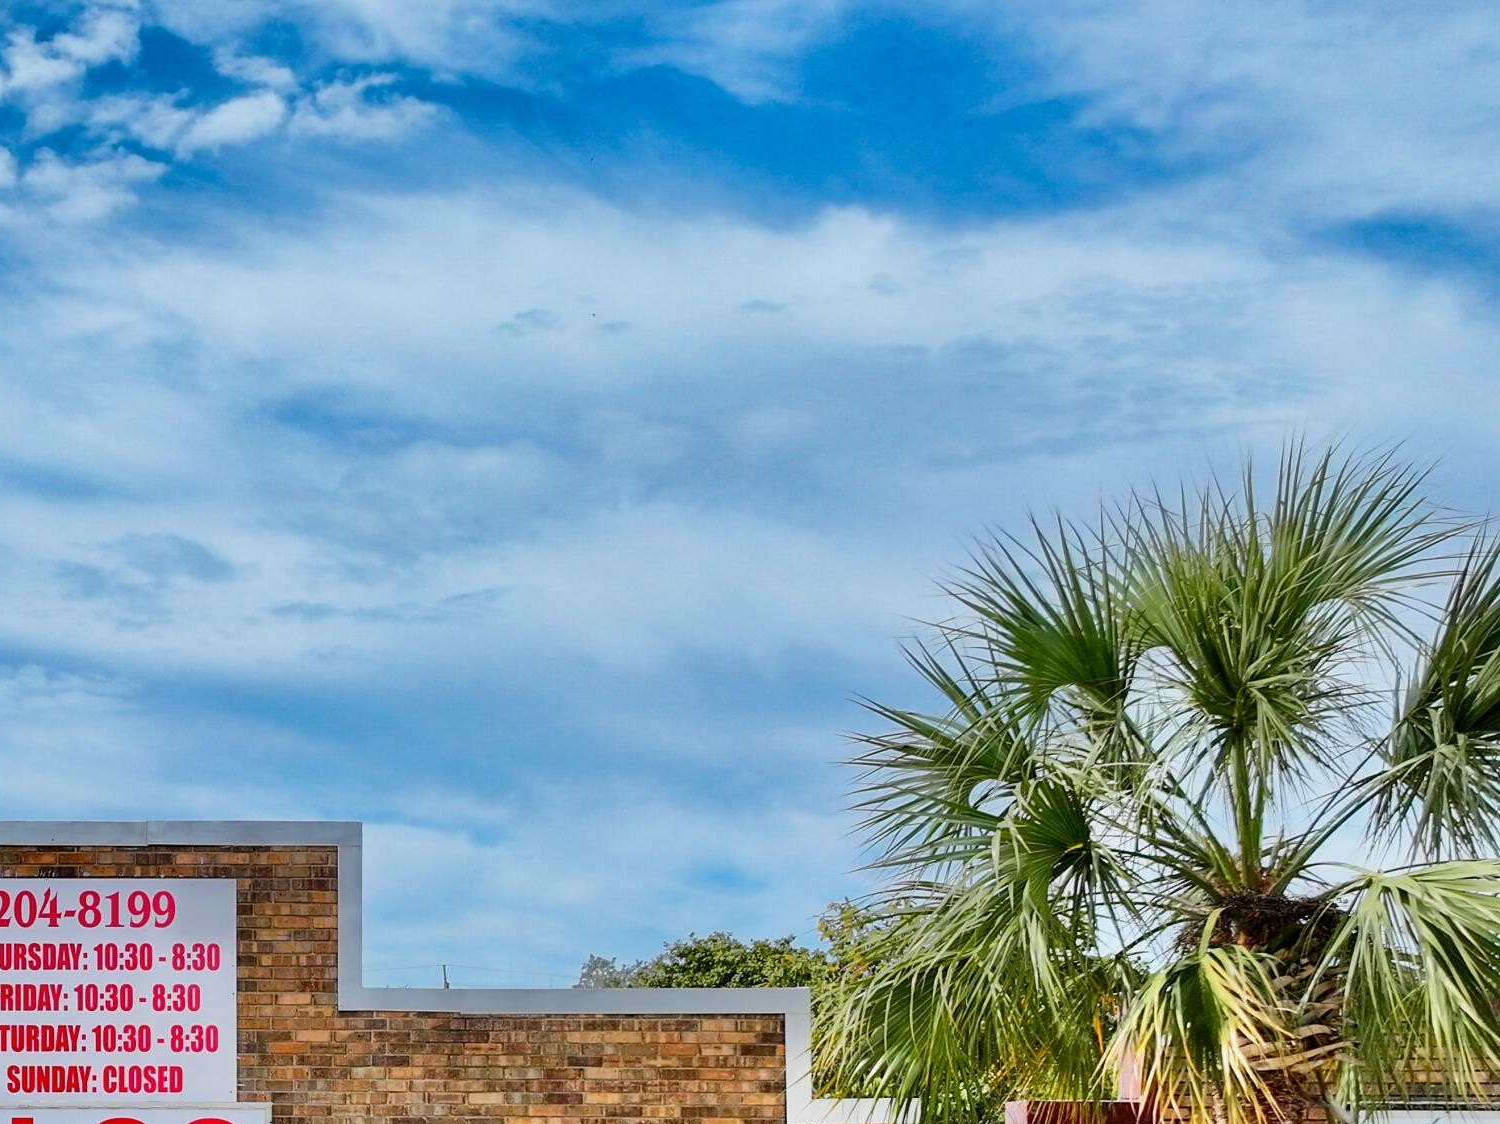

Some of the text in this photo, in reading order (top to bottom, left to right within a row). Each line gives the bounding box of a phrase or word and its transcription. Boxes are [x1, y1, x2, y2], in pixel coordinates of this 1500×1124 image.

[93, 942, 154, 972] 10:30
[171, 942, 221, 972] 8:30
[74, 982, 134, 1013] 10:30
[151, 982, 202, 1013] 8:30
[91, 1023, 152, 1054] 10:30
[169, 1023, 220, 1054] 8:30
[6, 1064, 184, 1095] SUNDAY: CLOSED
